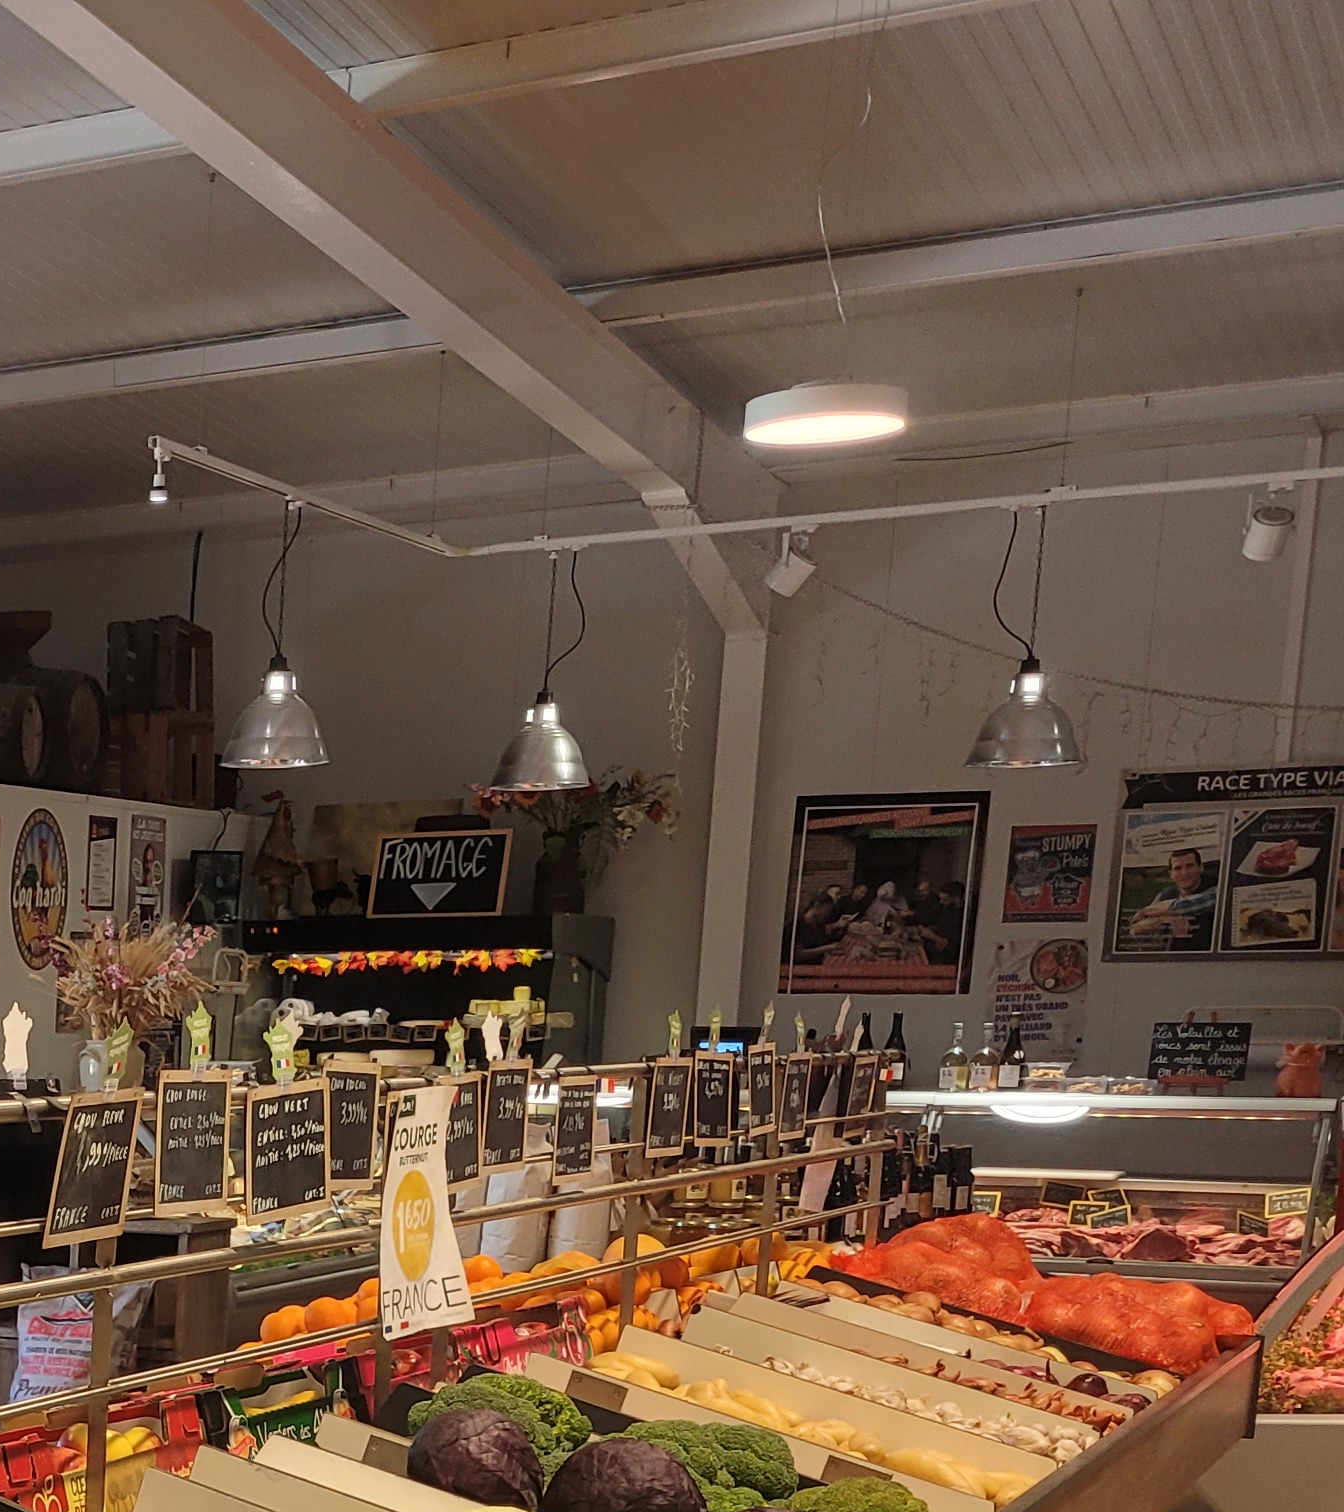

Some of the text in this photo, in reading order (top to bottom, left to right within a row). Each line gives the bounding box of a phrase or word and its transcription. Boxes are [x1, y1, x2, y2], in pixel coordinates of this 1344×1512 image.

[1197, 775, 1252, 791] RACE
[1256, 771, 1308, 789] TYPE
[1042, 833, 1092, 852] STUMPY
[379, 836, 493, 880] FROMAGE
[13, 880, 65, 912] Coq hardi
[1153, 1023, 1241, 1039] Les Volailles et
[1185, 1041, 1211, 1051] sont
[1216, 1041, 1247, 1052] issus
[1173, 1053, 1204, 1065] notre
[284, 1097, 310, 1113] VERT
[394, 1122, 438, 1152] COURGE
[399, 1152, 429, 1167] BUTTERNUT
[159, 1183, 185, 1201] FRANCE
[253, 1196, 279, 1214] FRANCE
[53, 1205, 89, 1231] FRANCE
[382, 1274, 468, 1324] FRANCE
